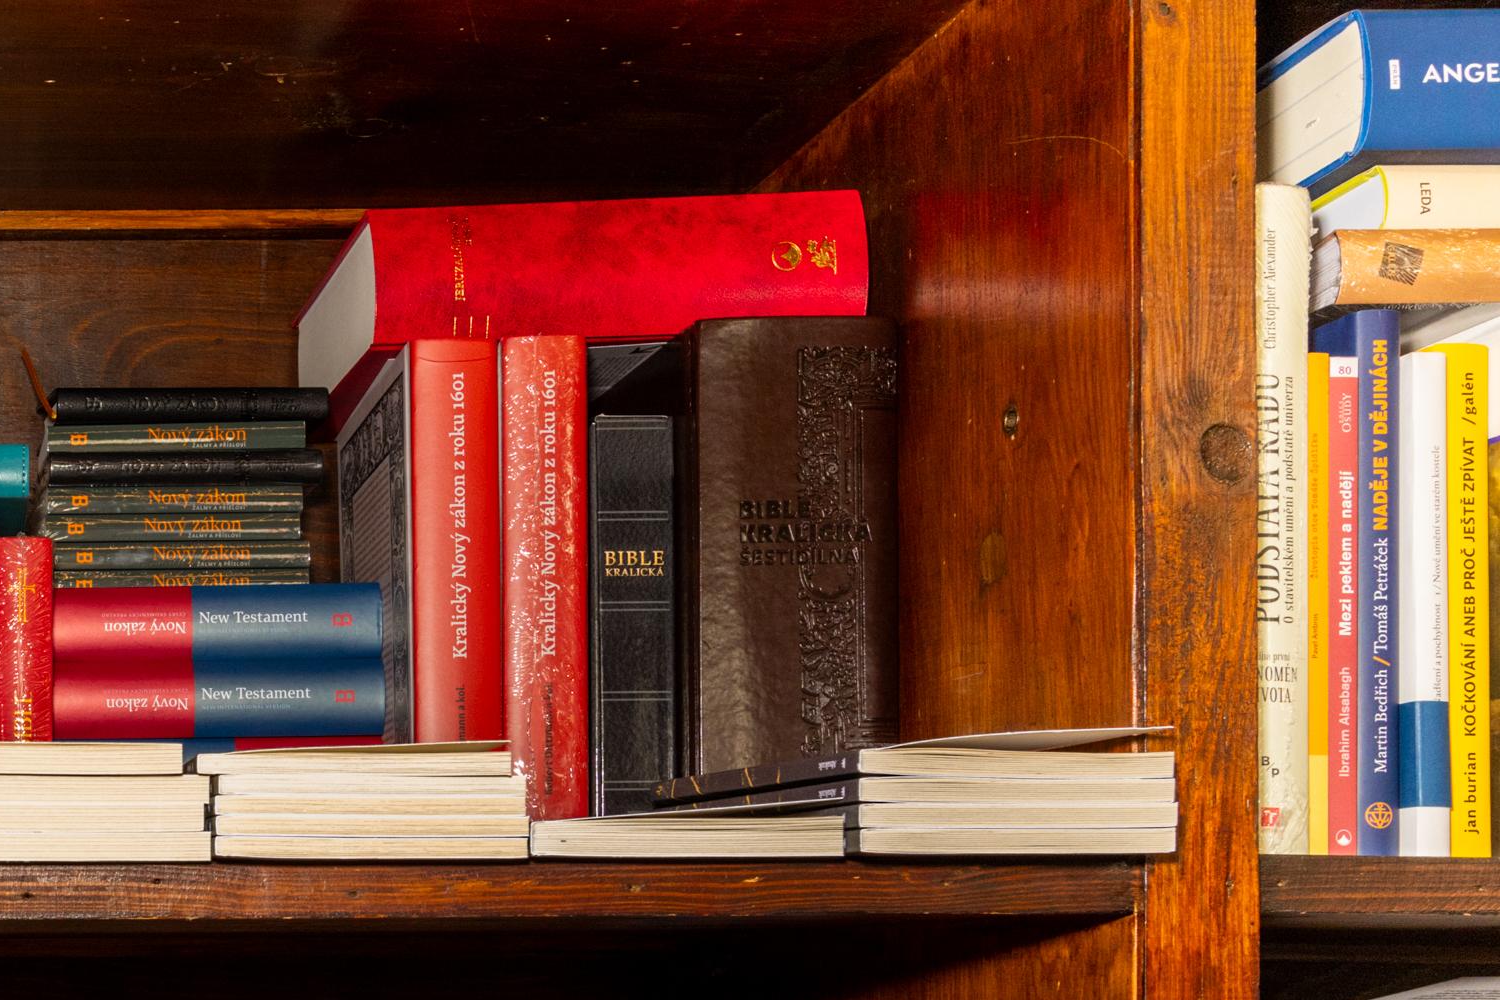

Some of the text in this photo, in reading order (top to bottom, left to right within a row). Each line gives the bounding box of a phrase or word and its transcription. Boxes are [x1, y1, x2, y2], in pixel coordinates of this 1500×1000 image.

[1420, 182, 1431, 215] LEDA
[1263, 228, 1280, 350] Christopher Alexander
[1338, 366, 1352, 375] 80
[1368, 339, 1388, 436] DĚJINÁCH
[1284, 376, 1294, 428] univerza
[148, 424, 247, 446] Nový zákon
[1282, 430, 1297, 481] podstatě
[1372, 443, 1388, 453] V
[1461, 437, 1475, 491] ZPÍVAT
[449, 371, 471, 660] Kralický Nový zákon z roku 1601
[539, 369, 560, 657] Kralický Nový zákon z roku 1601
[739, 499, 813, 519] BIBLE
[1285, 498, 1294, 532] umění
[1368, 455, 1388, 531] NADĚJE
[1460, 497, 1475, 543] JEŠTĚ
[604, 550, 665, 566] BIBLE
[605, 565, 665, 577] KRALICKÁ
[1283, 536, 1295, 613] stavitelském
[1338, 470, 1354, 636] Mezi peklem a nadějí
[1373, 537, 1388, 601] Petráček
[1461, 548, 1476, 590] PROČ
[104, 620, 146, 636] zákon
[149, 620, 187, 635] Nový
[199, 610, 309, 624] New Testament
[1373, 601, 1388, 654] Tomáš
[1463, 596, 1476, 638] ANEB
[106, 696, 189, 712] Nový zákon
[201, 687, 232, 700] New
[235, 686, 311, 700] Testament
[1373, 669, 1388, 722] Bedřich
[1460, 643, 1476, 737] KOČKOVÁNÍ
[1339, 667, 1353, 777] Ibrahim Alsabagh
[1374, 723, 1388, 773] Martin
[1463, 752, 1477, 803] burian
[1464, 808, 1480, 834] jan
